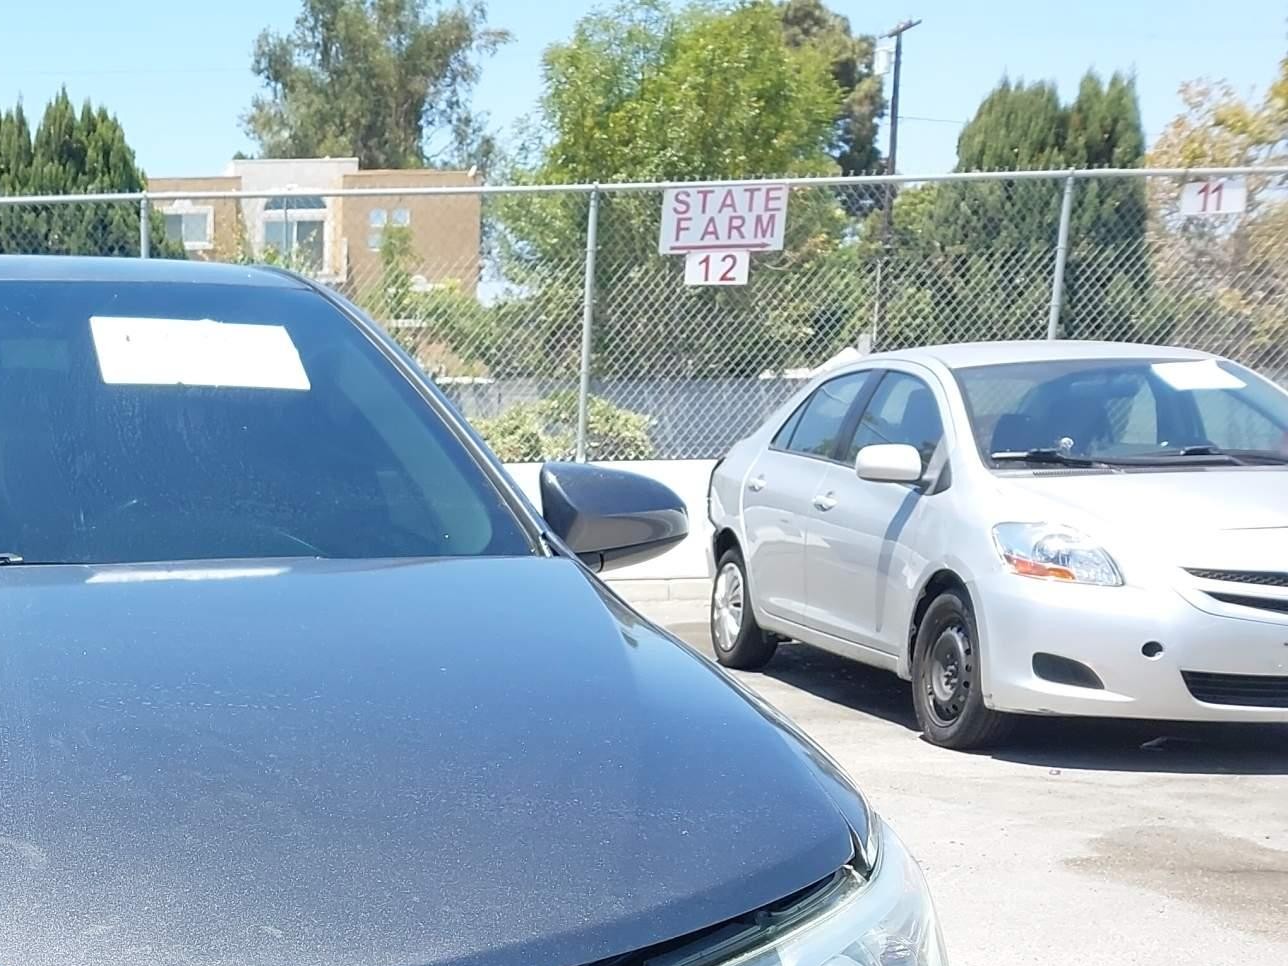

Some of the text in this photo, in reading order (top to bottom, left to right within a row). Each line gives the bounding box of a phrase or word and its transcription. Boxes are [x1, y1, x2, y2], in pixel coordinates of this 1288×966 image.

[672, 187, 783, 214] STATE
[1197, 183, 1224, 211] 11
[674, 214, 776, 241] FARM
[698, 254, 737, 281] 12
